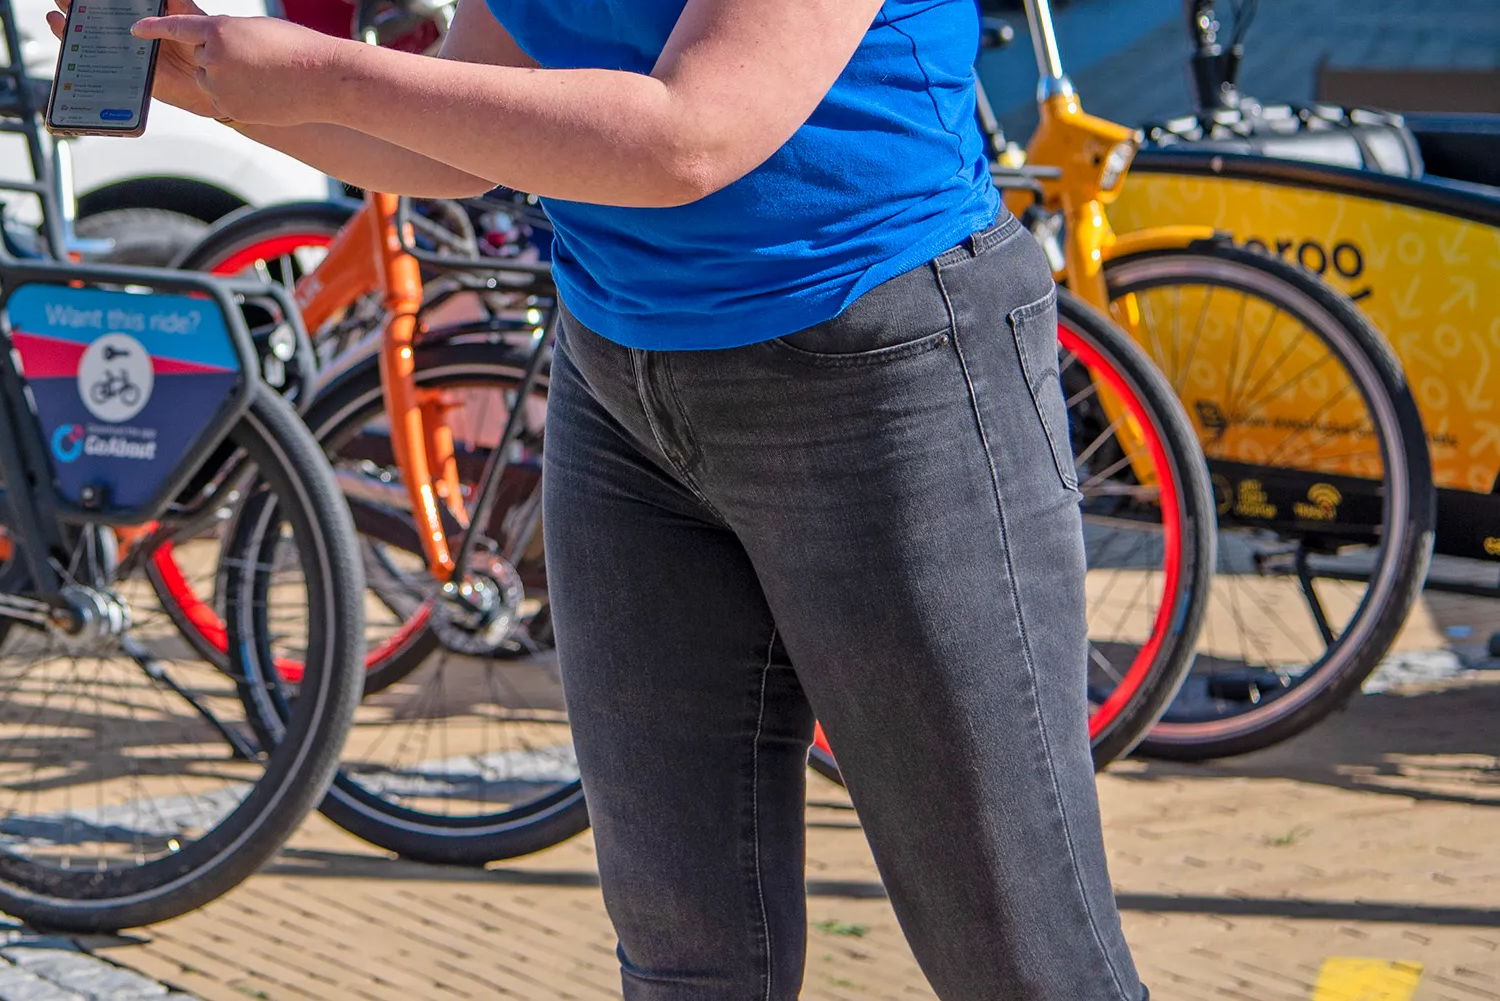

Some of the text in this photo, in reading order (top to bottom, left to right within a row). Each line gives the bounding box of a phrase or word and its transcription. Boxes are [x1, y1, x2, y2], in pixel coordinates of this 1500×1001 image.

[45, 303, 201, 335] Want this ride?
